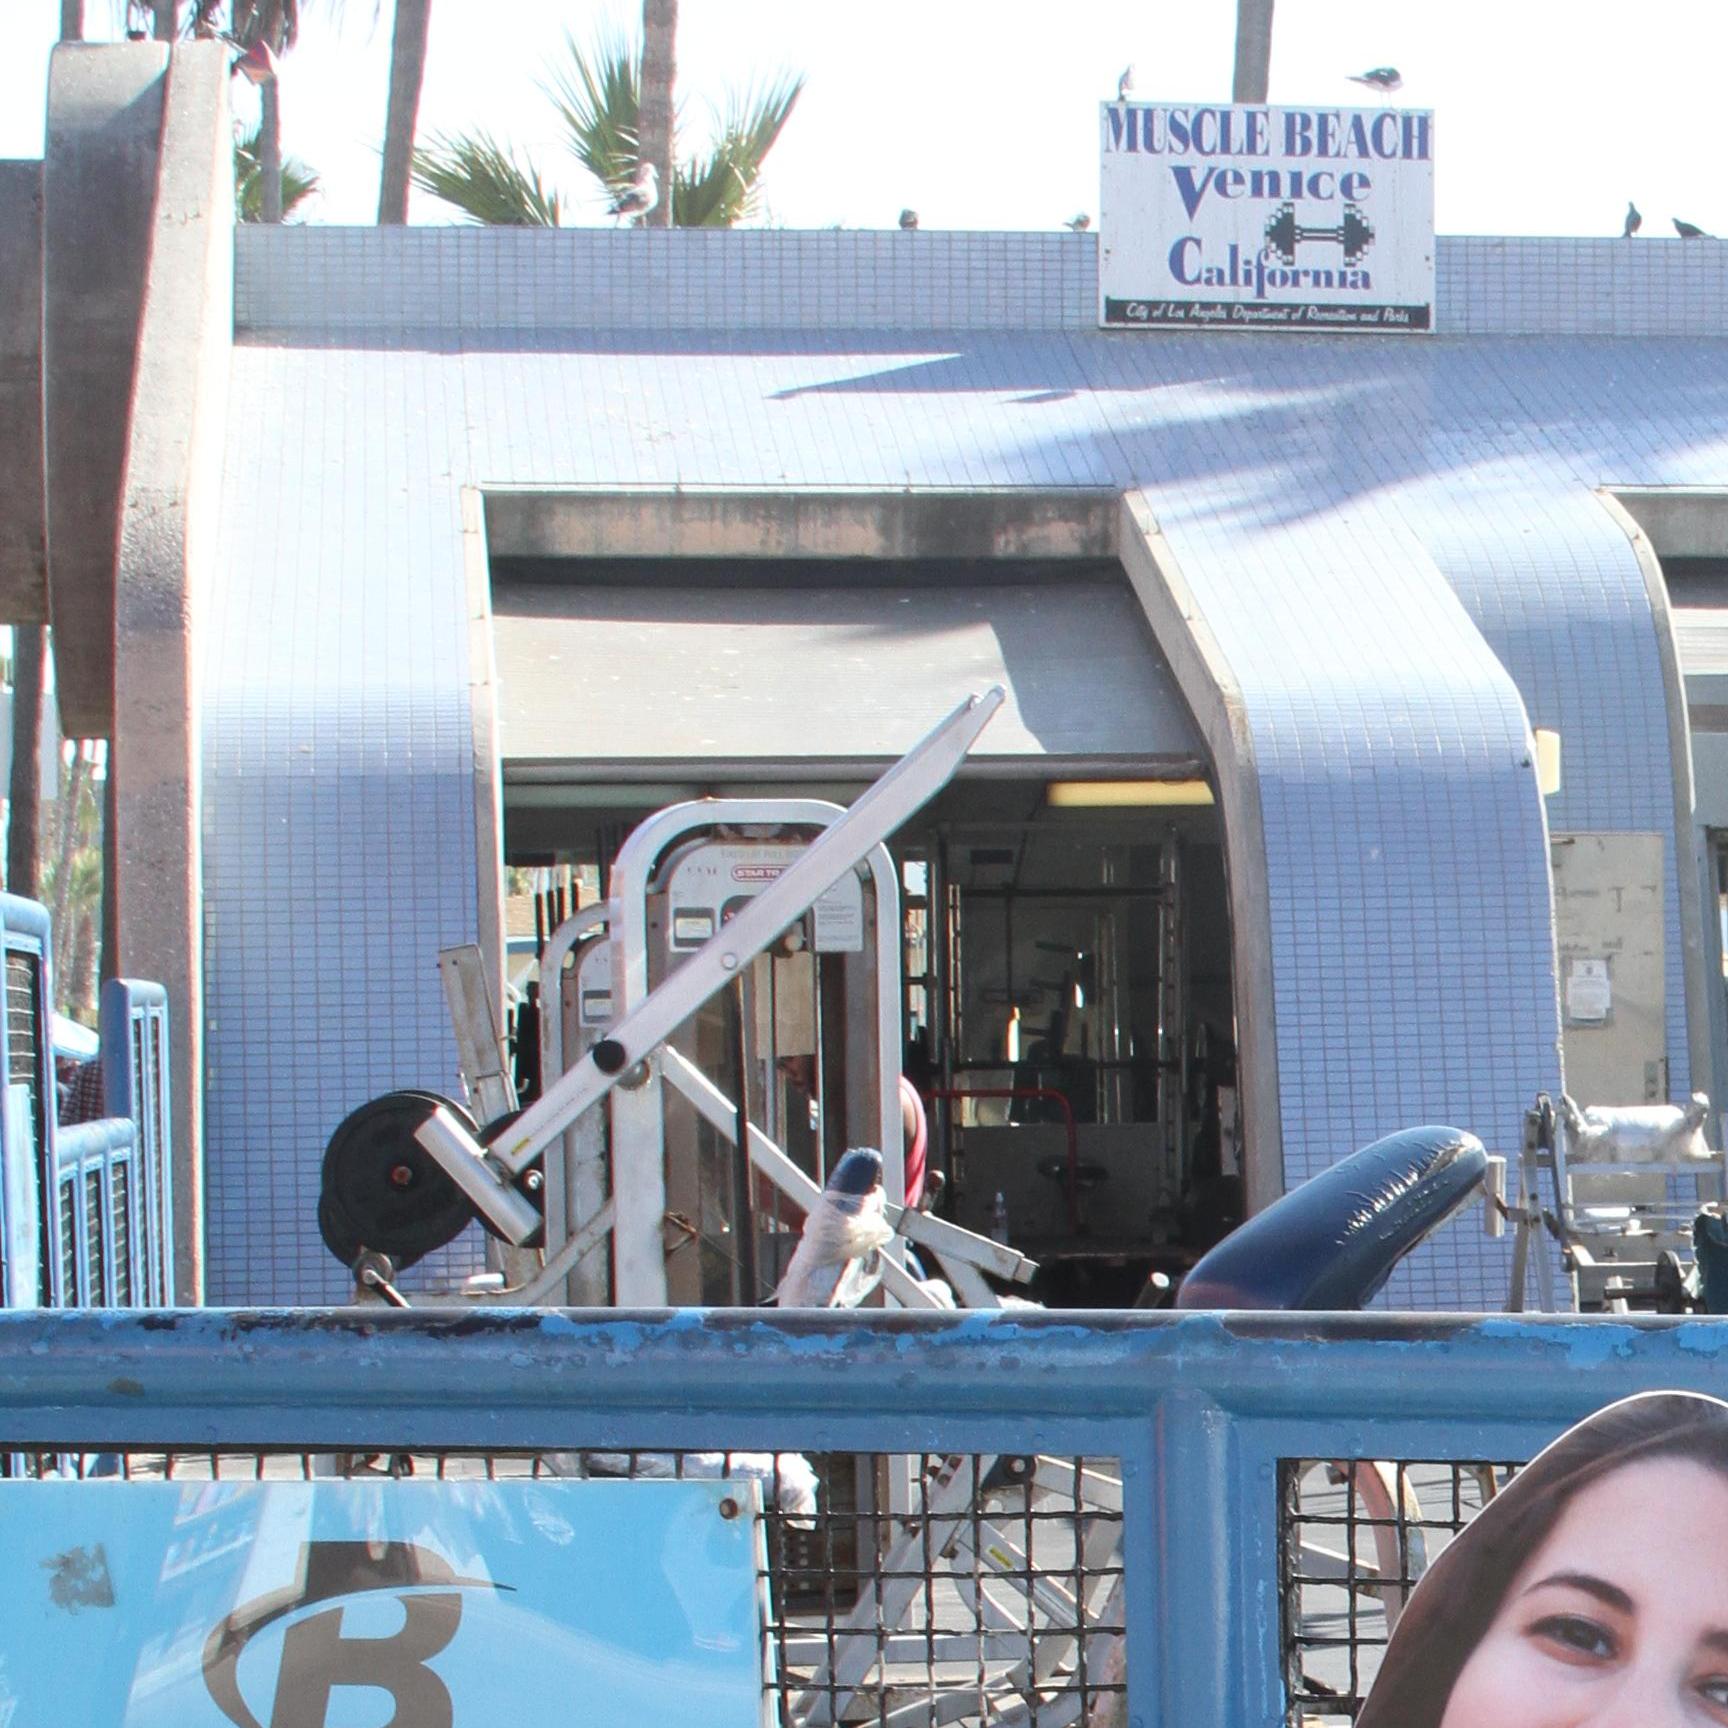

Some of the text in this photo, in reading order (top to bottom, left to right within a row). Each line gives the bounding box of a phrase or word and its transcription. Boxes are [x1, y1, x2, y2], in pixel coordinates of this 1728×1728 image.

[1104, 107, 1433, 160] MUSCLE BEACH
[1169, 165, 1373, 223] Venice
[1168, 235, 1373, 299] California
[1126, 302, 1149, 319] City
[1152, 302, 1165, 318] of
[1232, 304, 1290, 324] Department
[1291, 304, 1303, 320] of
